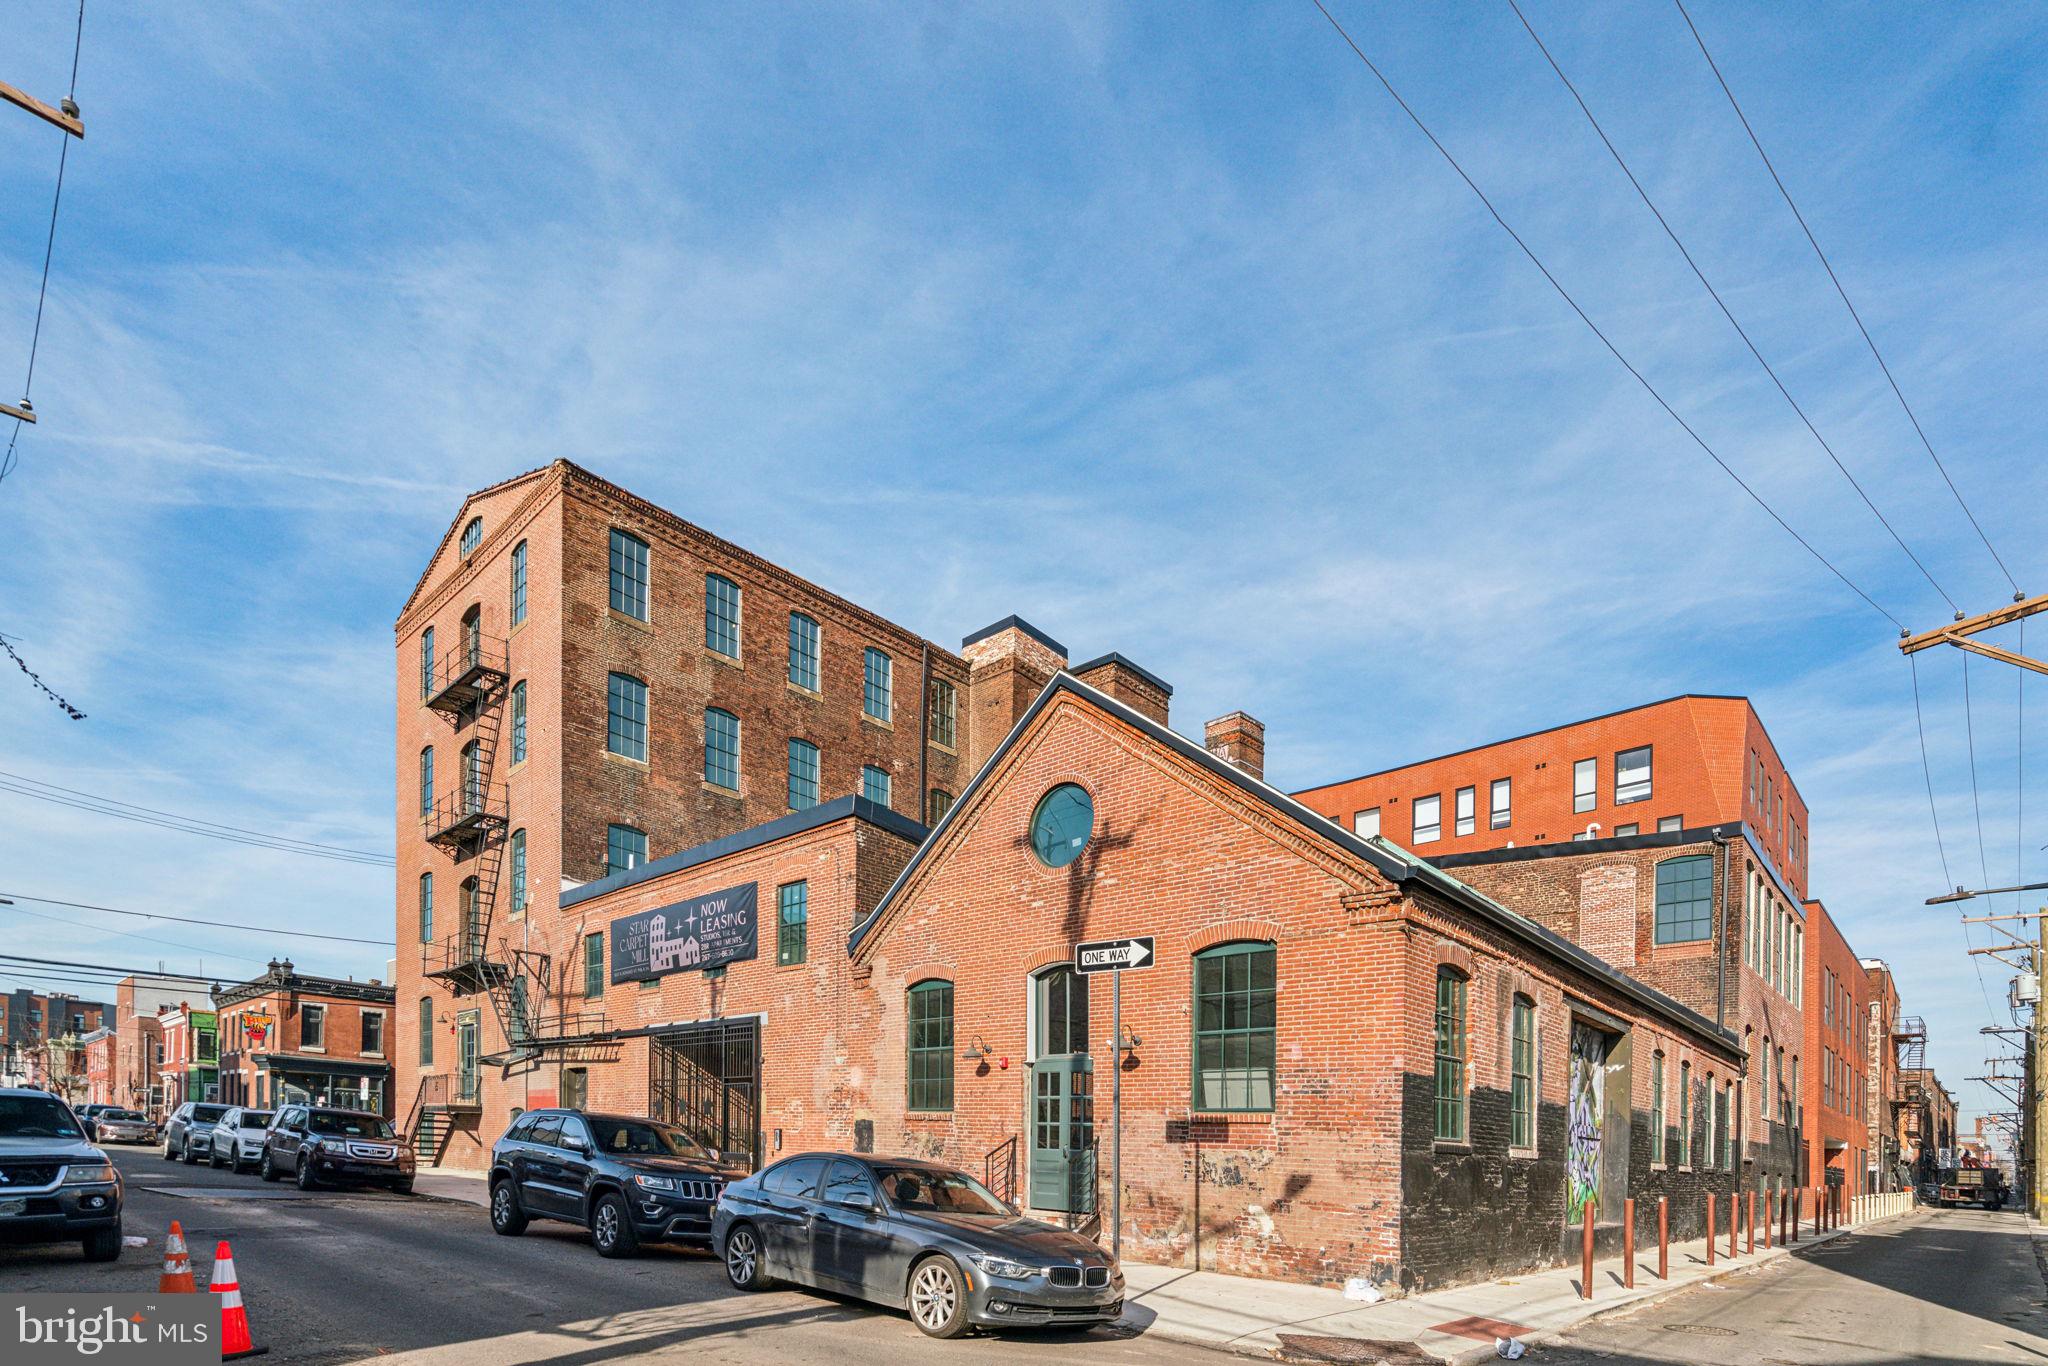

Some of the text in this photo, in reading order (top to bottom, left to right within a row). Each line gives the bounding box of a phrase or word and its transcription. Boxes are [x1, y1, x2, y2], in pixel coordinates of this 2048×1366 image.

[701, 898, 728, 918] NOW
[629, 919, 649, 936] STAR
[700, 910, 746, 934] LEASING
[620, 933, 648, 953] CARPET
[631, 948, 649, 964] MILL
[1084, 948, 1130, 964] ONE WAY
